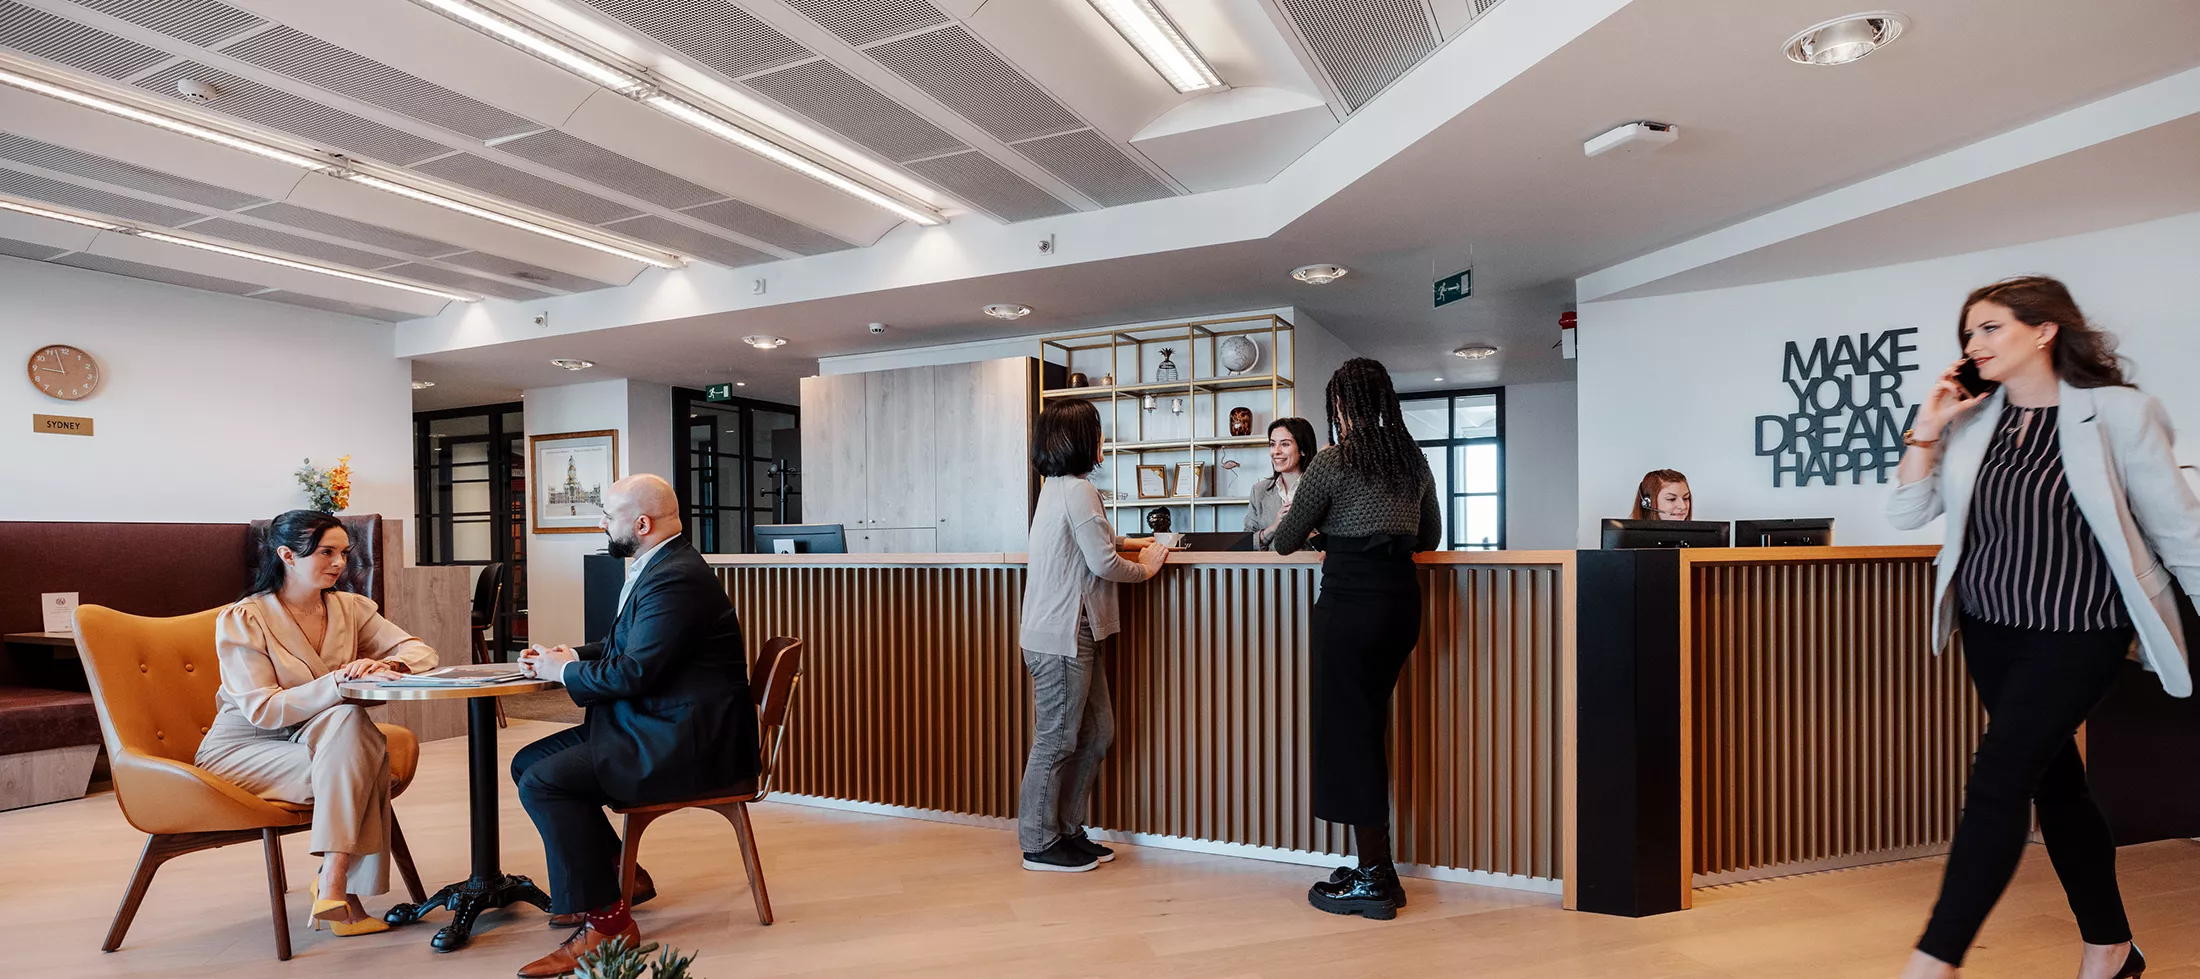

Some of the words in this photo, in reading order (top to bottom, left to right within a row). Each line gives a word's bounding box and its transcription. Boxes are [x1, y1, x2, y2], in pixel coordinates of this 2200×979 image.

[32, 364, 38, 372] 9
[1782, 327, 1919, 382] MAKE
[1787, 371, 1904, 415] YOUR
[46, 420, 81, 430] SYDNEY
[1755, 404, 1921, 456] DREAM
[1773, 446, 1902, 487] HAPPE
